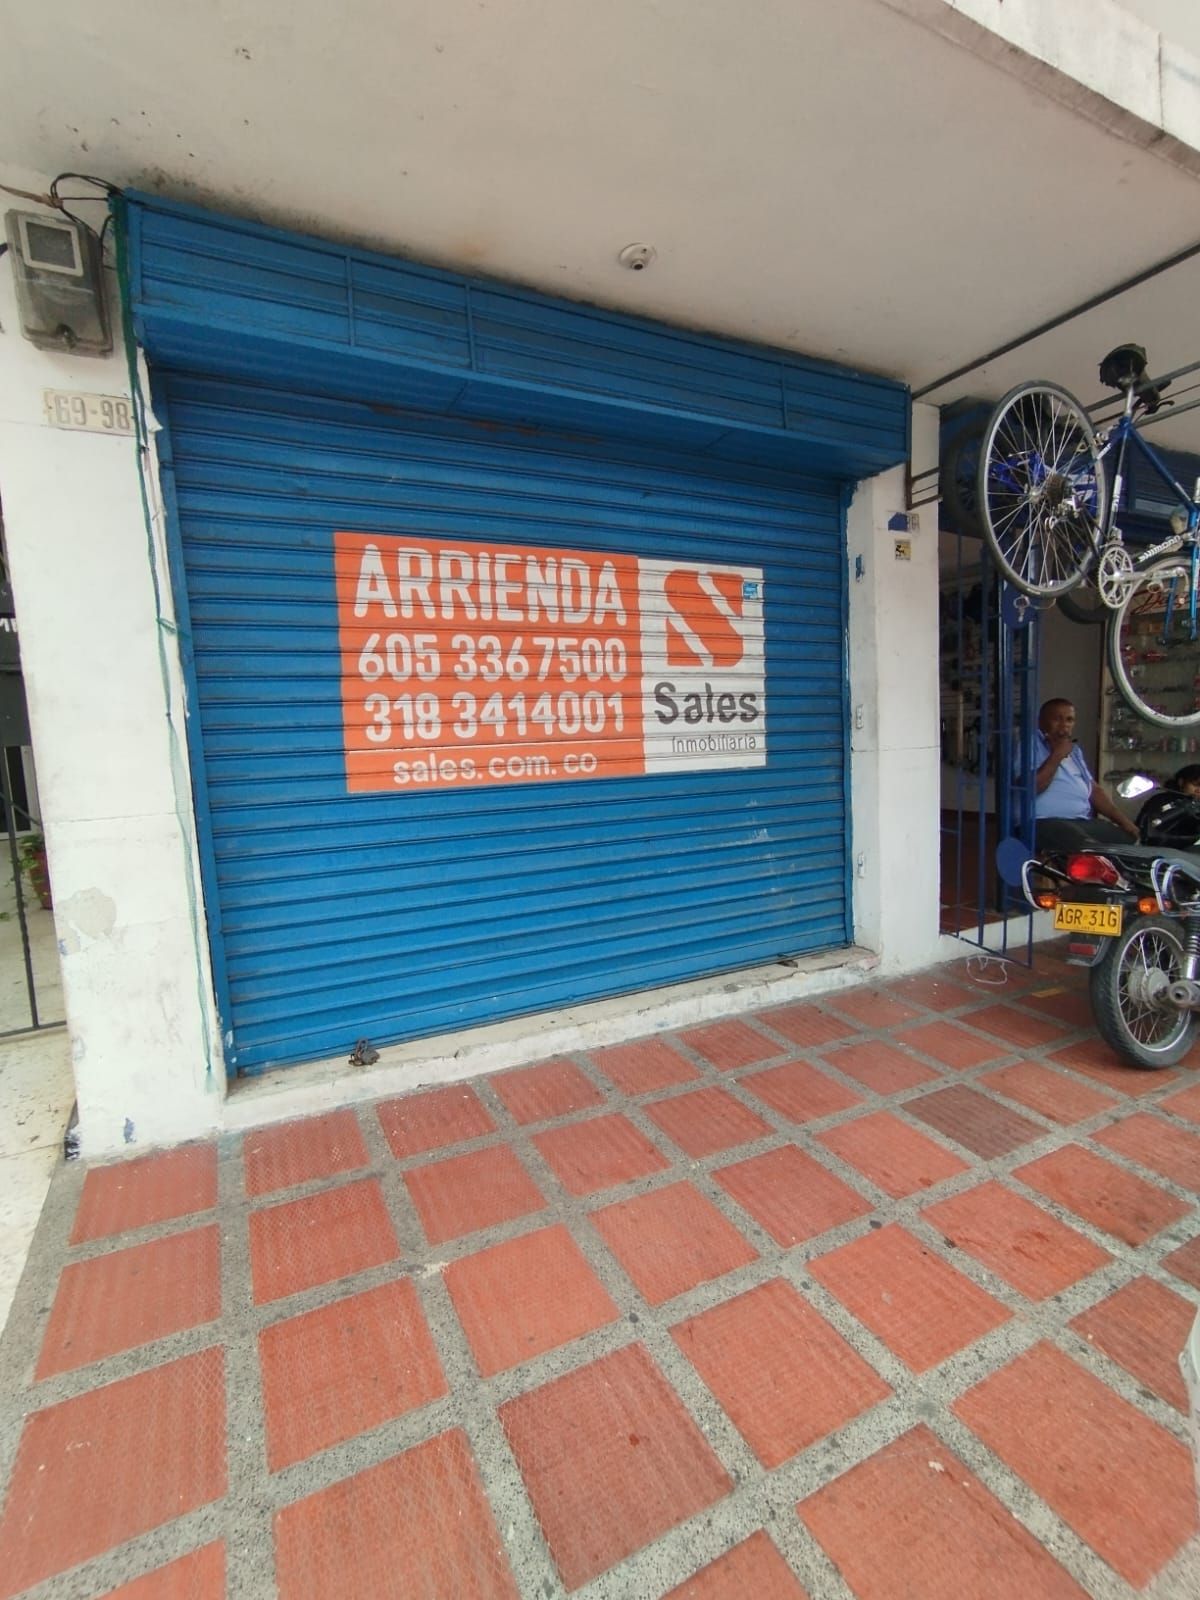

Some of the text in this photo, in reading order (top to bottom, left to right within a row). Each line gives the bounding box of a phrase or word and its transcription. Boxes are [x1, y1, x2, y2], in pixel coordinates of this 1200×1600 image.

[54, 395, 130, 429] 69-98
[354, 543, 627, 626] ARRIENDA
[358, 633, 627, 682] 605 3367500
[364, 691, 624, 742] 318 3414001
[654, 682, 759, 724] Sales
[1056, 907, 1083, 925] AGR
